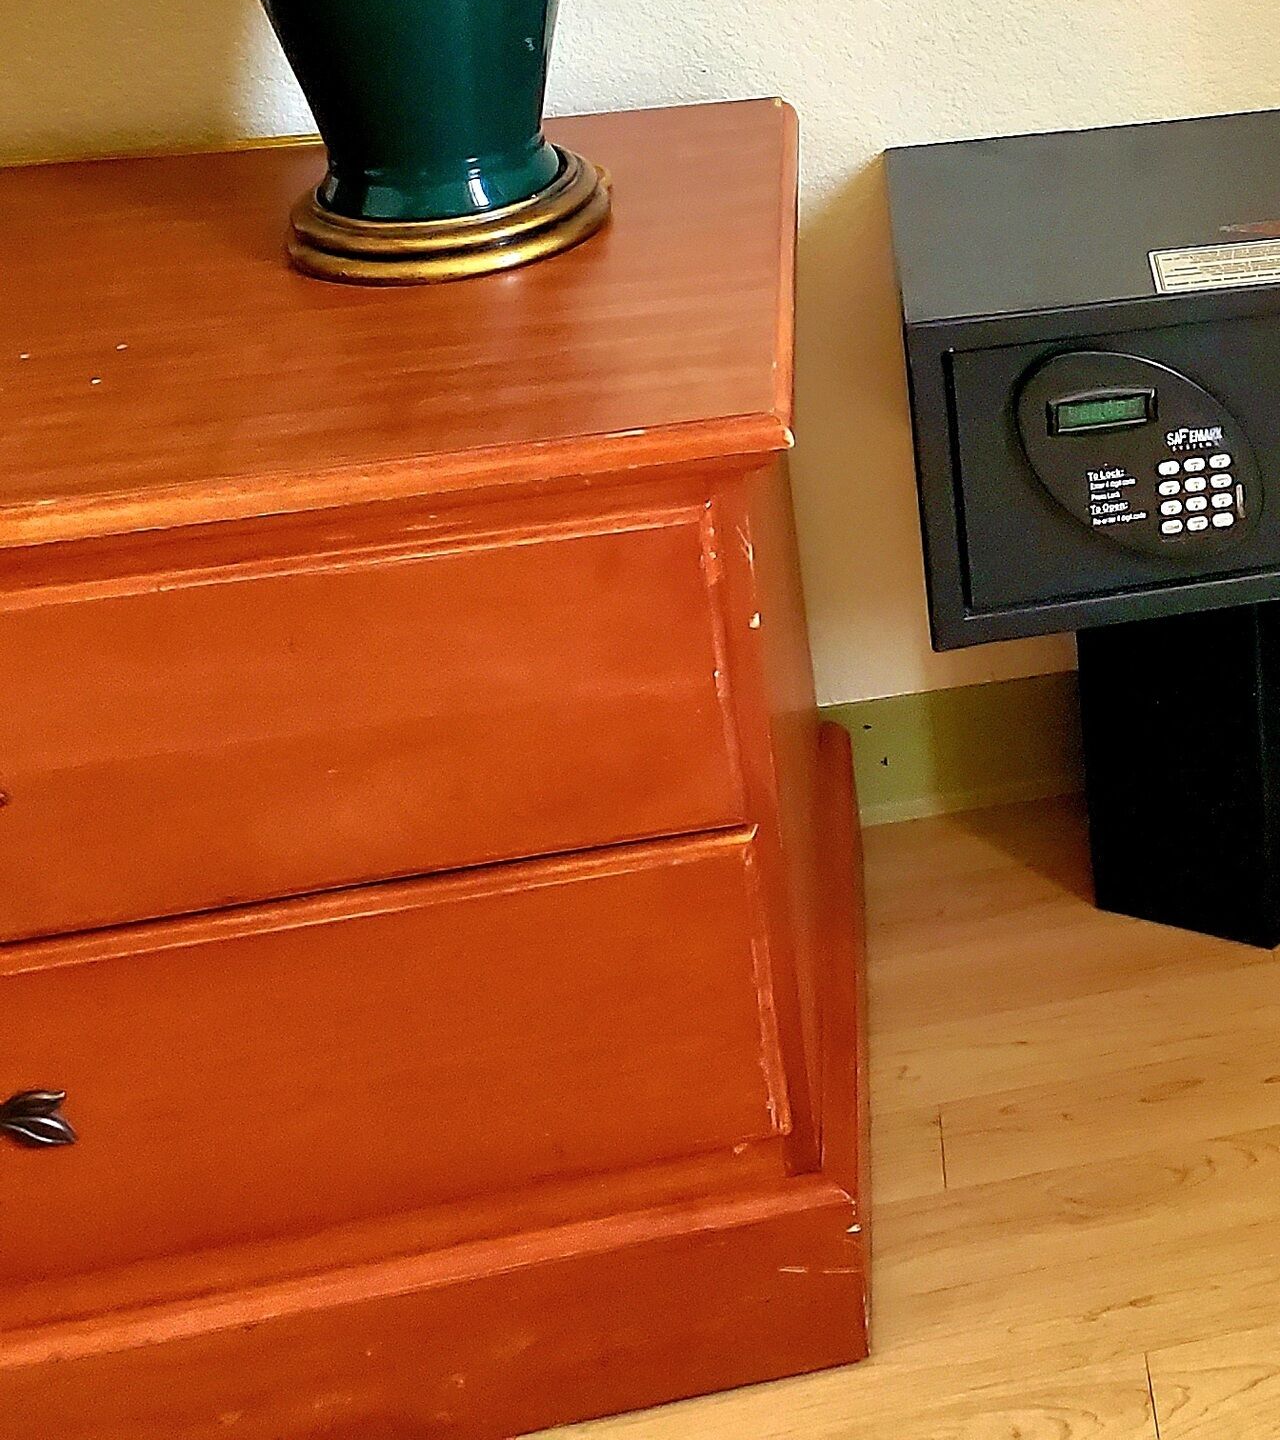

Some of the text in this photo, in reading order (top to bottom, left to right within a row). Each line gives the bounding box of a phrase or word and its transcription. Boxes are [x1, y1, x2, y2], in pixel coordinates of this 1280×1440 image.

[1087, 468, 1125, 482] To Lock:
[1090, 504, 1102, 515] To
